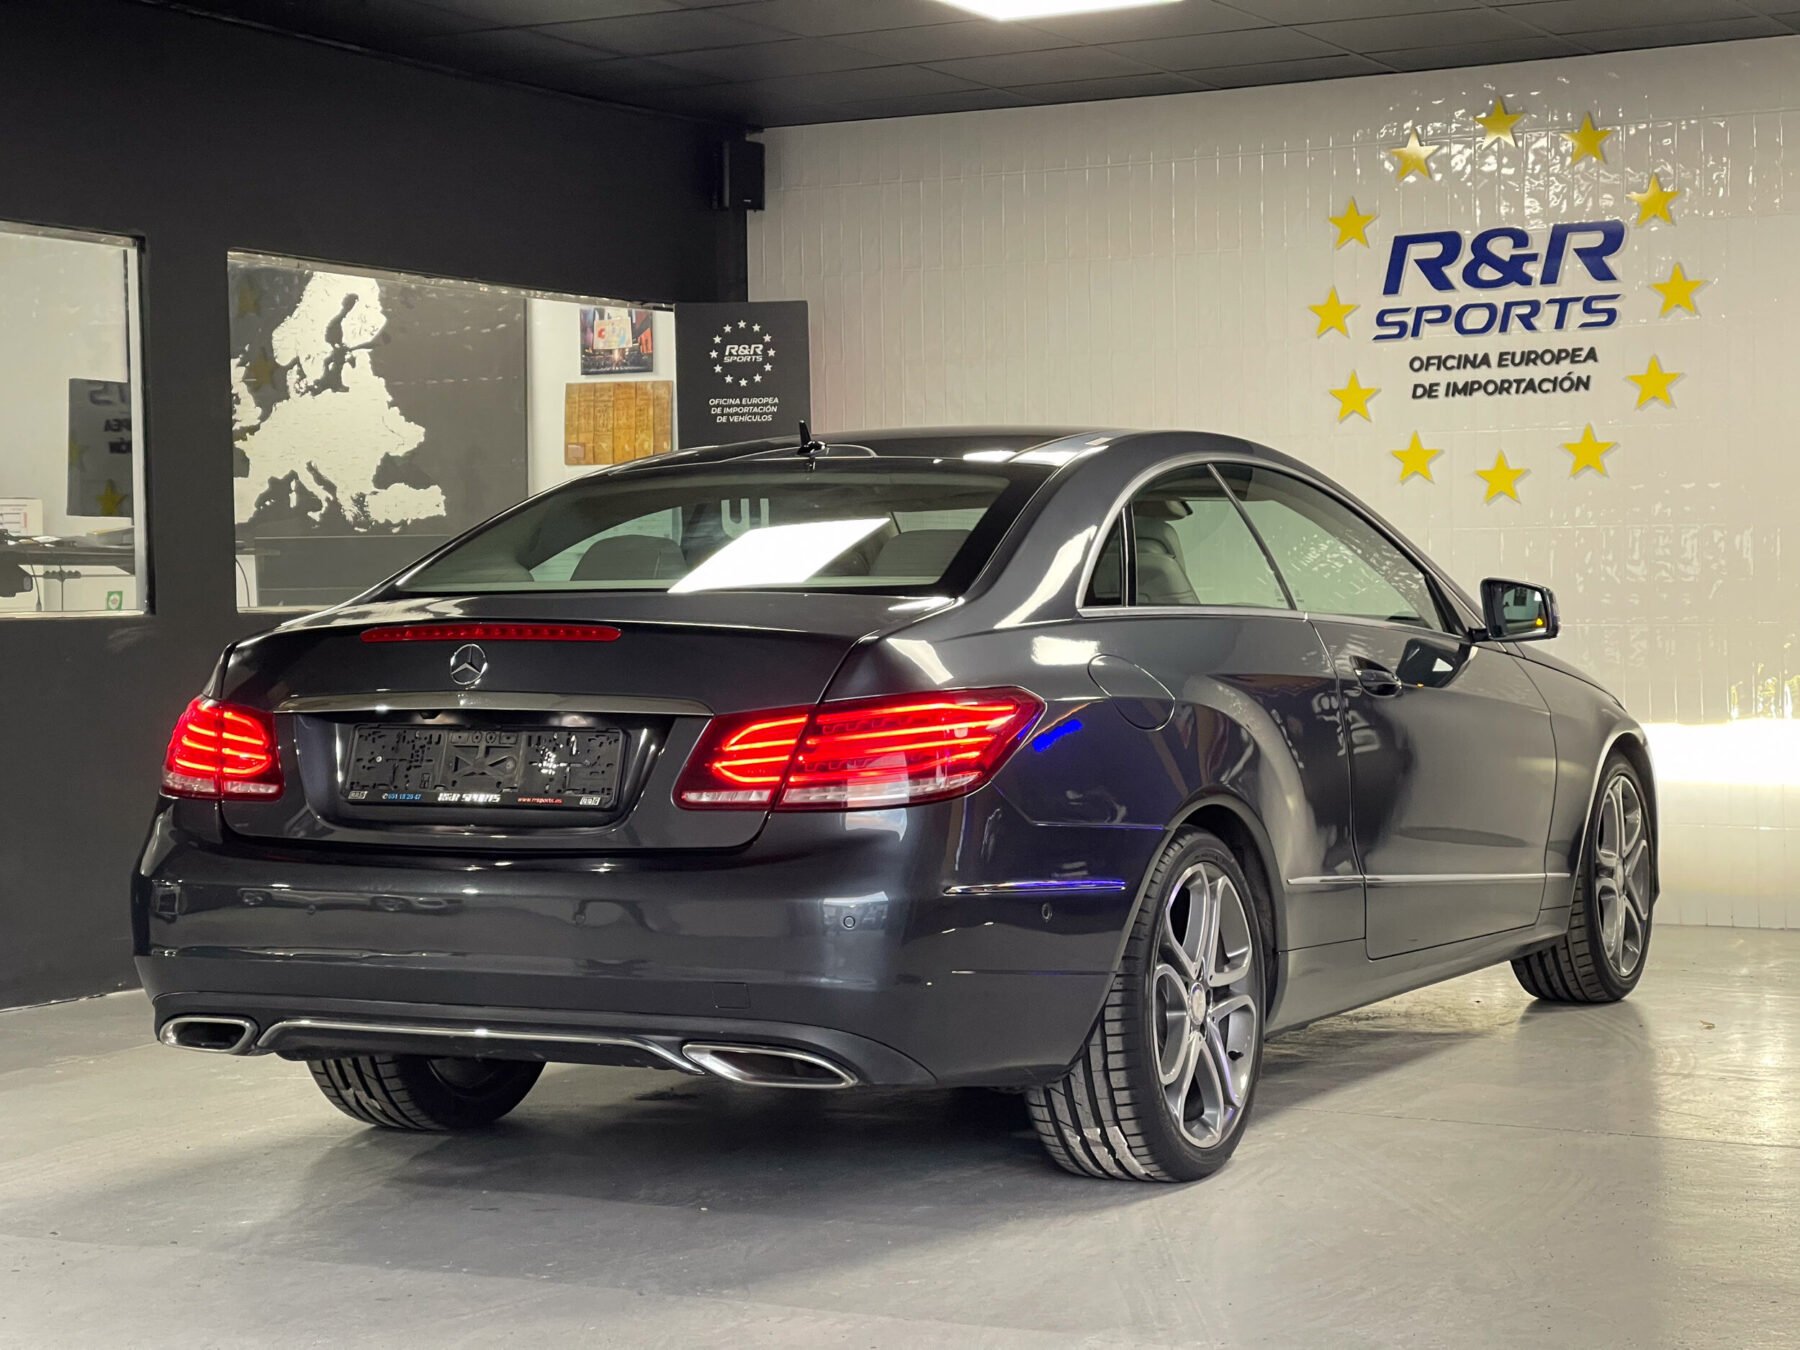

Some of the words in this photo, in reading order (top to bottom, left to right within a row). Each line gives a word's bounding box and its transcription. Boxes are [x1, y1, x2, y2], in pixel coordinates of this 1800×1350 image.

[1382, 219, 1625, 295] R&R
[1372, 294, 1623, 341] SPORTS
[725, 344, 764, 355] R&R
[723, 355, 763, 363] SPORTS
[1409, 352, 1492, 373] OFICINA
[1497, 347, 1599, 368] EUROPEA
[1411, 382, 1441, 400] DE
[1444, 372, 1592, 398] IMPORTACIÓN
[708, 397, 740, 406] OFICINA
[742, 396, 779, 405] EUROPEA
[723, 405, 778, 414] IMPORTACIÓN
[716, 415, 727, 423] DE
[728, 414, 773, 422] VEHÍCULOS
